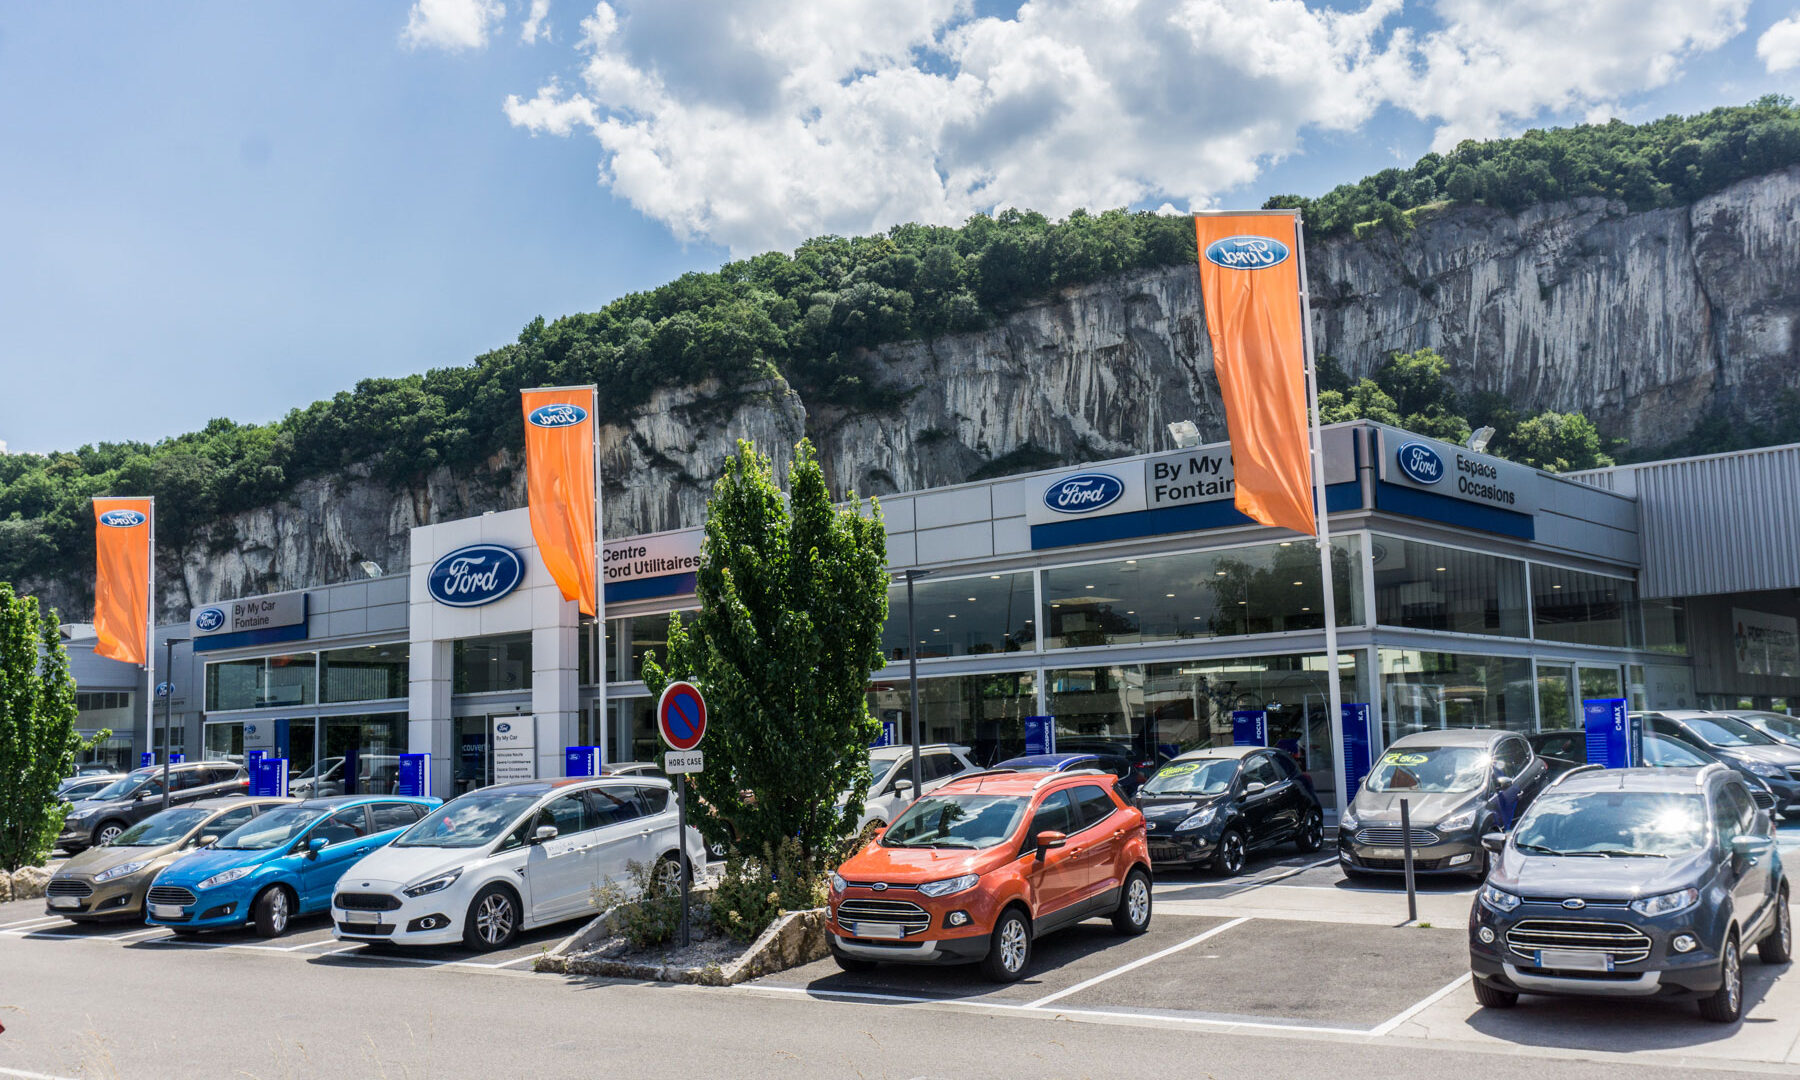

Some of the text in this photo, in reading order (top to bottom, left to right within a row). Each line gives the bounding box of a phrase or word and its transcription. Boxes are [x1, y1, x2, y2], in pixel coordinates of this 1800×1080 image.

[1154, 462, 1182, 481] By
[1189, 455, 1223, 475] My
[1410, 447, 1437, 477] Ford
[1456, 453, 1497, 479] Espace
[1058, 480, 1105, 507] Ford
[1154, 476, 1235, 502] Fontain
[1458, 475, 1515, 505] Occasions
[603, 546, 646, 562] Centre
[634, 556, 701, 575] Utilitaires
[444, 556, 500, 595] Ford
[199, 612, 218, 628] Ford
[235, 600, 276, 617] By My Car
[235, 615, 270, 629] Fontaine
[668, 757, 702, 767] HORS CASE
